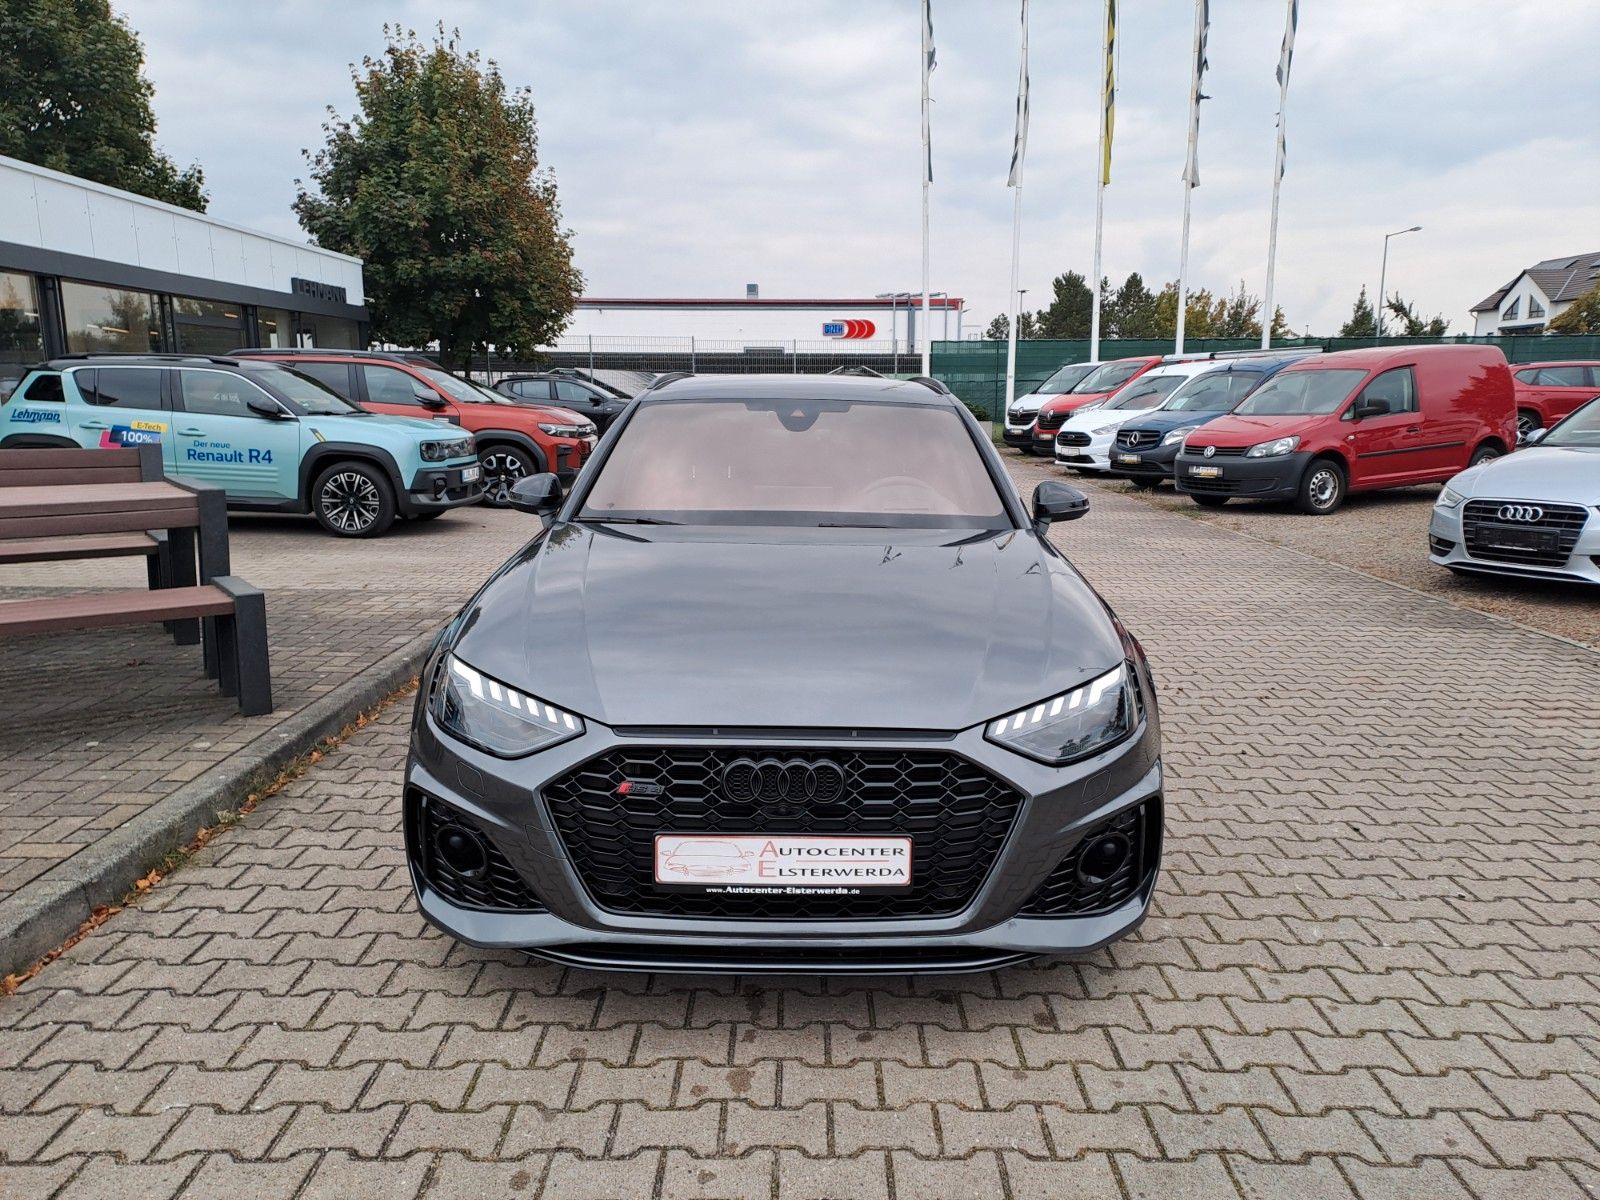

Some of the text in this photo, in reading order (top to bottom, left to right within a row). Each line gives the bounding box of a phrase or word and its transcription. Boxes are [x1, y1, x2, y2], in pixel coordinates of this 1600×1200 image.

[11, 408, 60, 422] Lehmann
[136, 422, 161, 431] E-Tech
[121, 430, 153, 443] 100%
[193, 440, 208, 448] Der
[187, 448, 273, 464] Renault R4
[759, 840, 905, 858] AUTOCENTER
[758, 860, 905, 878] ELSTERWERDA
[705, 885, 860, 895] www.Autocenter-Elsterwerda.de
